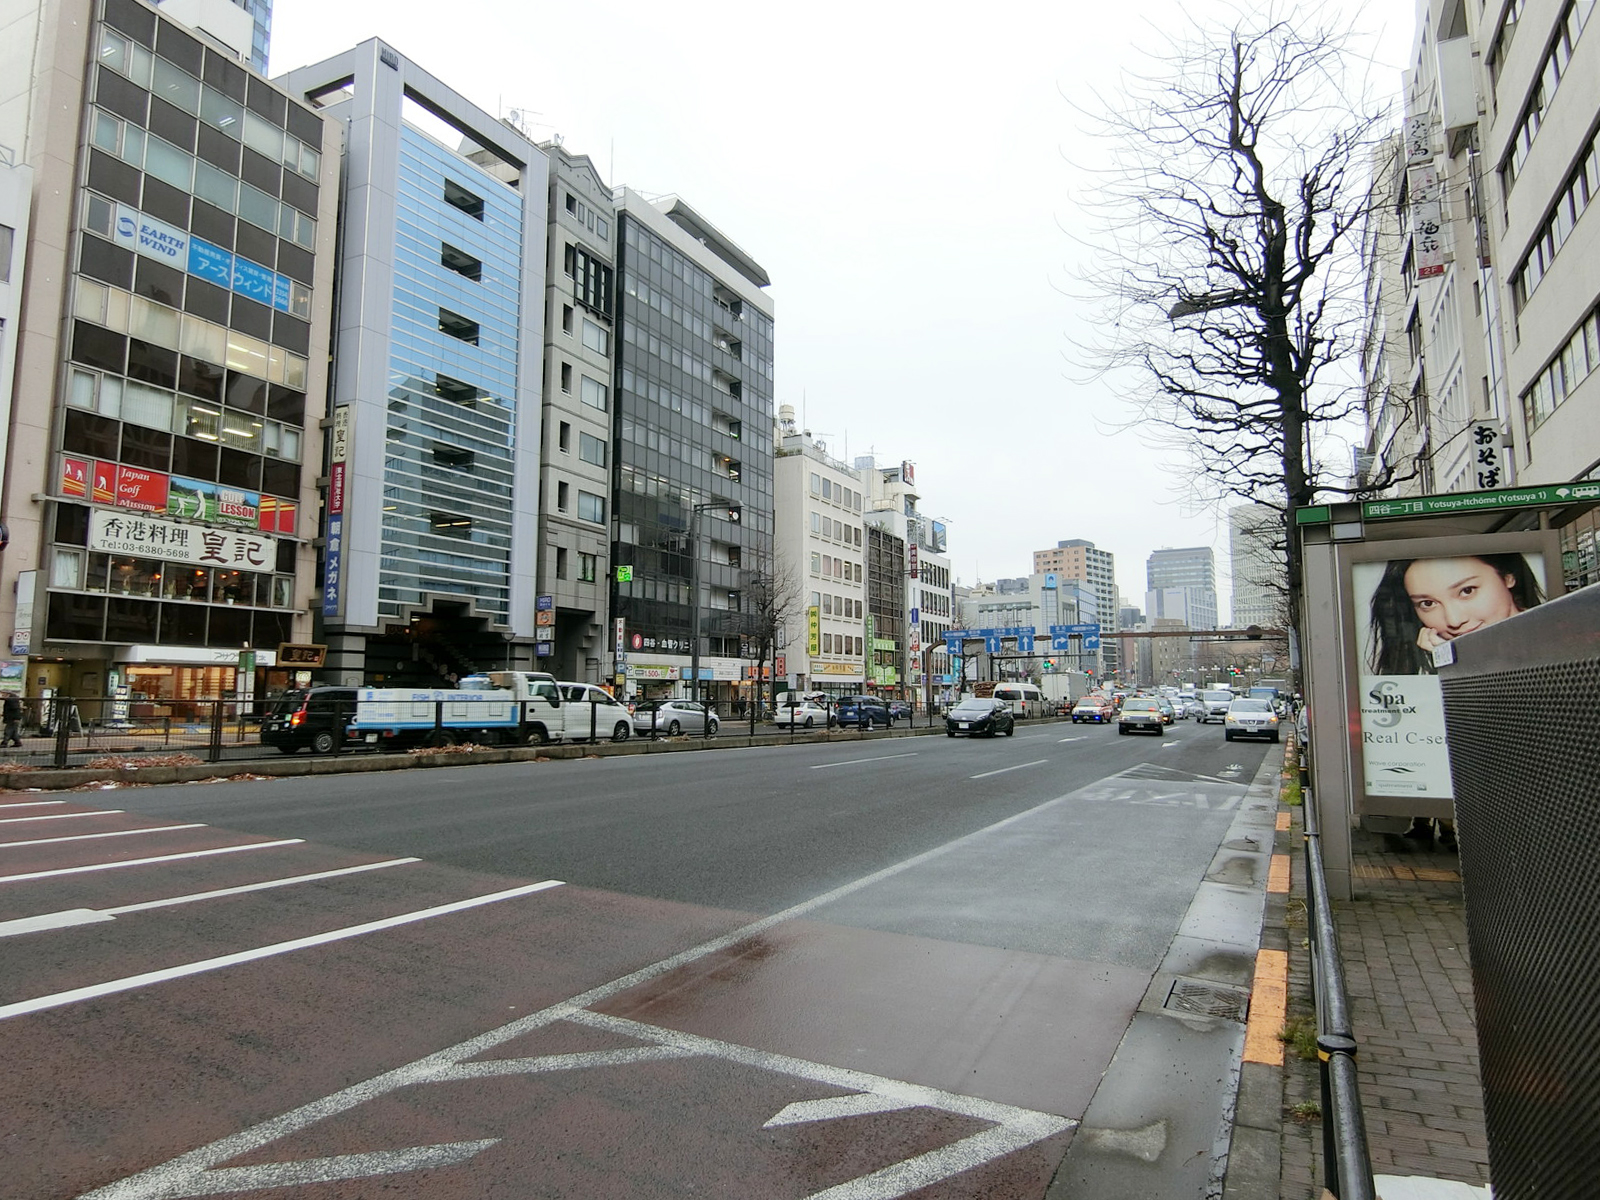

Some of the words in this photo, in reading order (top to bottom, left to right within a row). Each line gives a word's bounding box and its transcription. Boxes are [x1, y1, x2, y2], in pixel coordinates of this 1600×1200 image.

[139, 235, 177, 257] WIND
[140, 224, 185, 250] EARTH
[198, 257, 272, 298] アースウィンド
[1423, 266, 1437, 275] 2F
[1473, 426, 1501, 489] おそば
[120, 468, 151, 482] Japan
[119, 483, 141, 498] Golf
[221, 489, 246, 503] GOLF
[1498, 494, 1536, 504] (Yotsuya
[1538, 491, 1547, 500] 1)
[220, 501, 256, 520] LESSON
[1369, 501, 1424, 515] 四谷一丁目
[102, 517, 190, 548] 香港料理
[199, 530, 266, 567] 皇記
[327, 521, 341, 600] 朝倉メガネ
[1369, 690, 1405, 709] Spa
[1402, 706, 1416, 714] eX
[1363, 731, 1398, 744] Real
